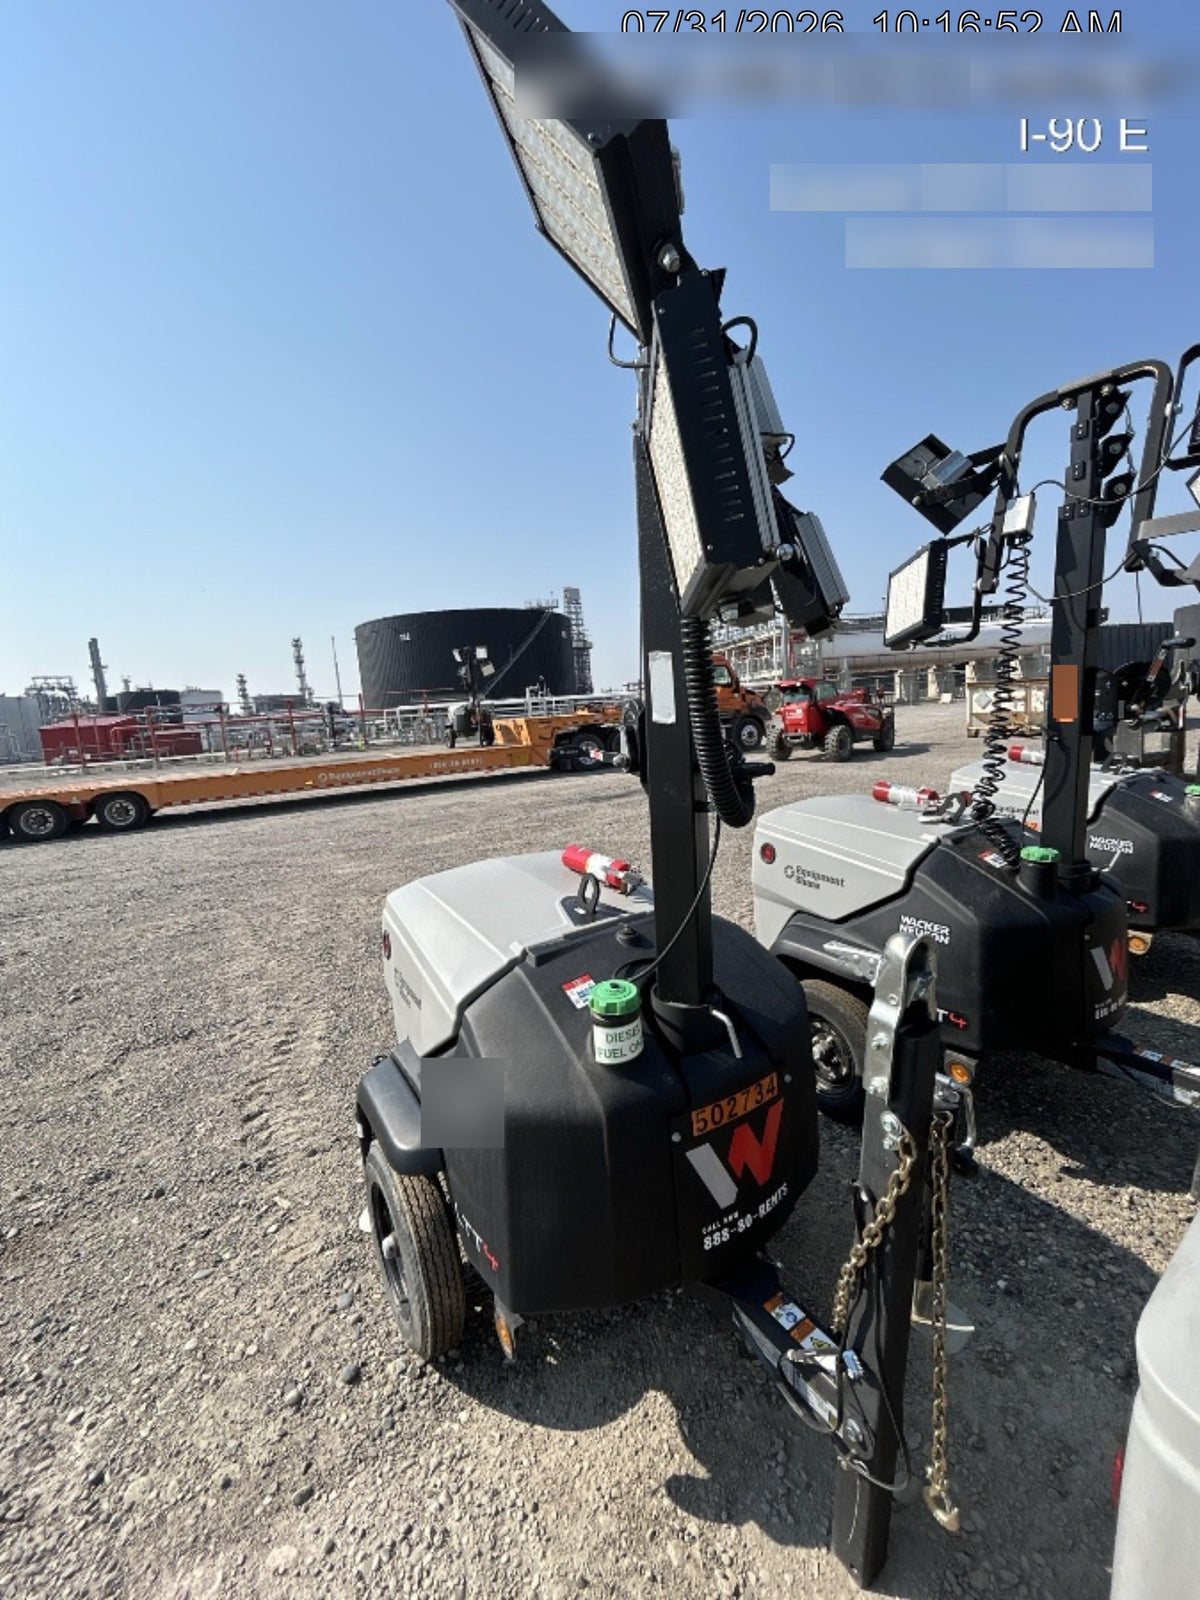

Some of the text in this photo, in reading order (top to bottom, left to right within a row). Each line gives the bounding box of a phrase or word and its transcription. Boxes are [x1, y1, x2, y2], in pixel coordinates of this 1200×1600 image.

[901, 914, 950, 936] WACKER
[597, 1046, 627, 1058] FUEL
[696, 1075, 776, 1133] 502734
